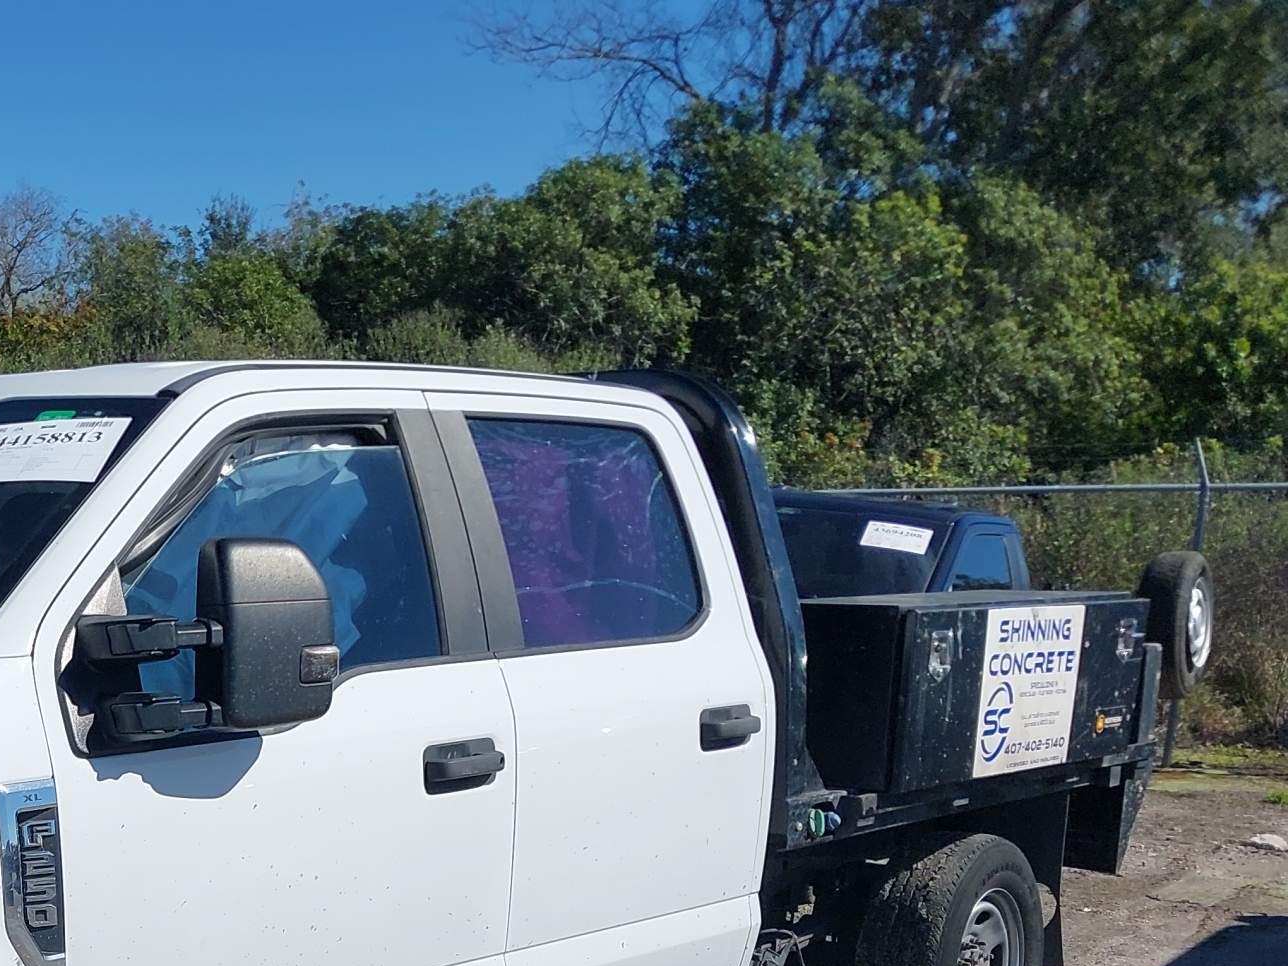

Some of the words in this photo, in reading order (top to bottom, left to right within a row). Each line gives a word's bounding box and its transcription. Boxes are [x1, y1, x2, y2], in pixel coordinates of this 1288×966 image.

[999, 618, 1072, 643] SHINNING
[989, 650, 1076, 677] CONCRETE
[983, 708, 1013, 737] SC
[1004, 736, 1065, 755] 407-402-5140
[23, 793, 43, 803] XL
